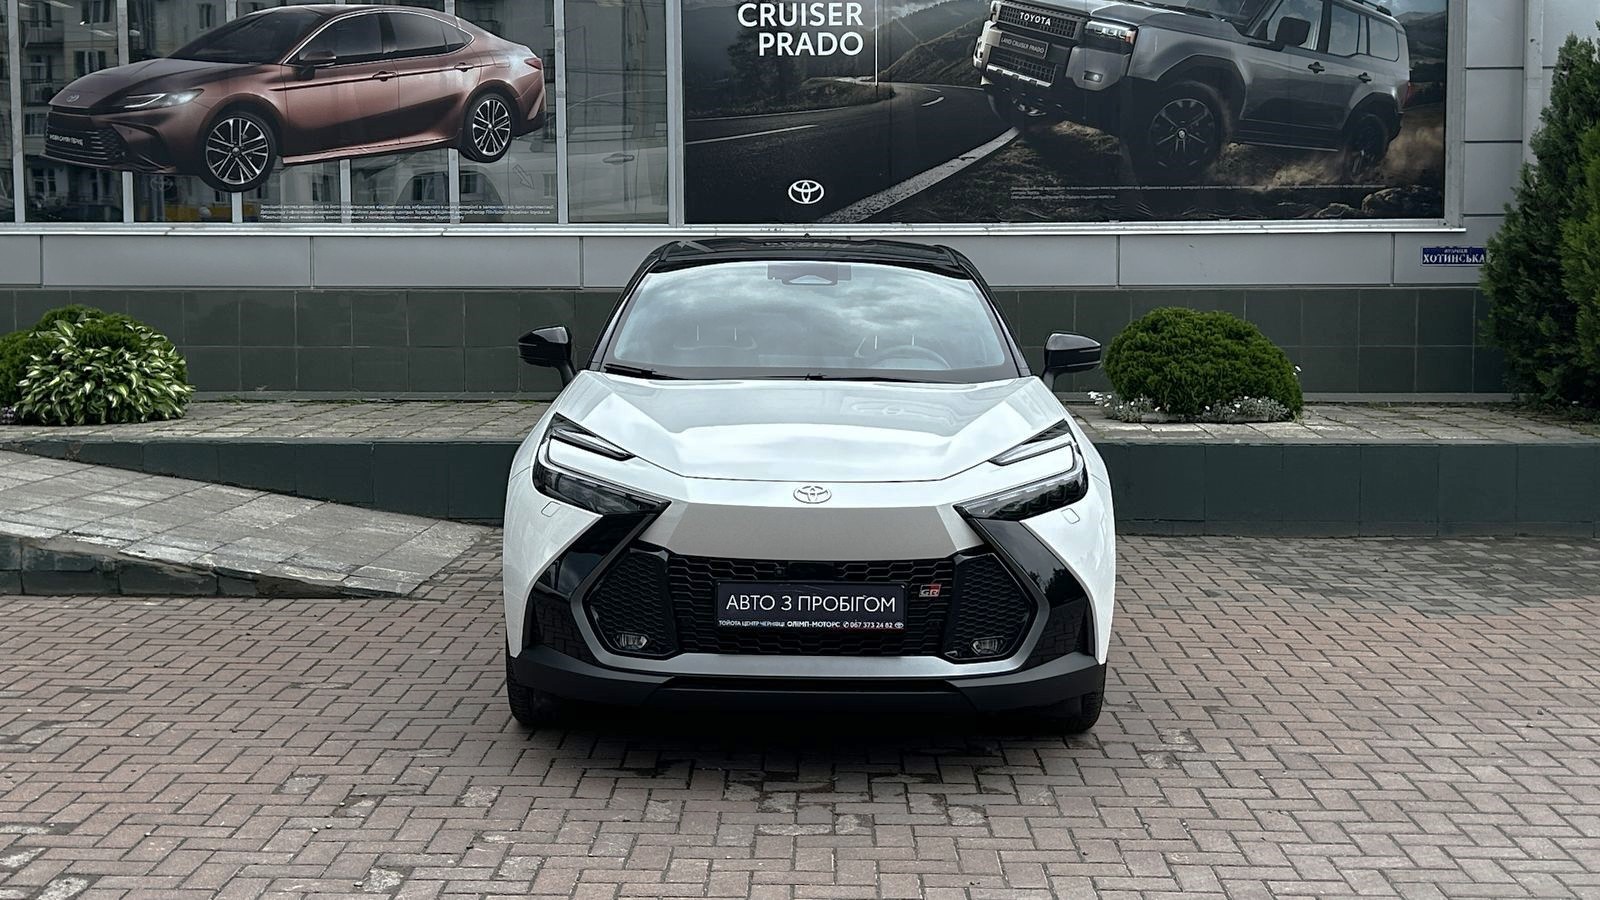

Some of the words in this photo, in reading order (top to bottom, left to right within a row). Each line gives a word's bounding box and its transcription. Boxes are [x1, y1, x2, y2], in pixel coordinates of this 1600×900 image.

[737, 2, 864, 27] CRUISER
[1019, 12, 1051, 26] TOYOTA
[758, 31, 864, 56] PRADO
[1000, 37, 1012, 45] LAND
[1011, 39, 1030, 50] CRUISER
[1028, 44, 1045, 54] PRADO
[1423, 253, 1485, 264] ХОТИНСЬКА
[726, 594, 776, 611] АВТО
[798, 595, 896, 613] ПРОБІГОМ
[786, 620, 841, 629] ОЛІМП-МОТОРС
[850, 620, 862, 629] 067
[862, 621, 875, 629] 373
